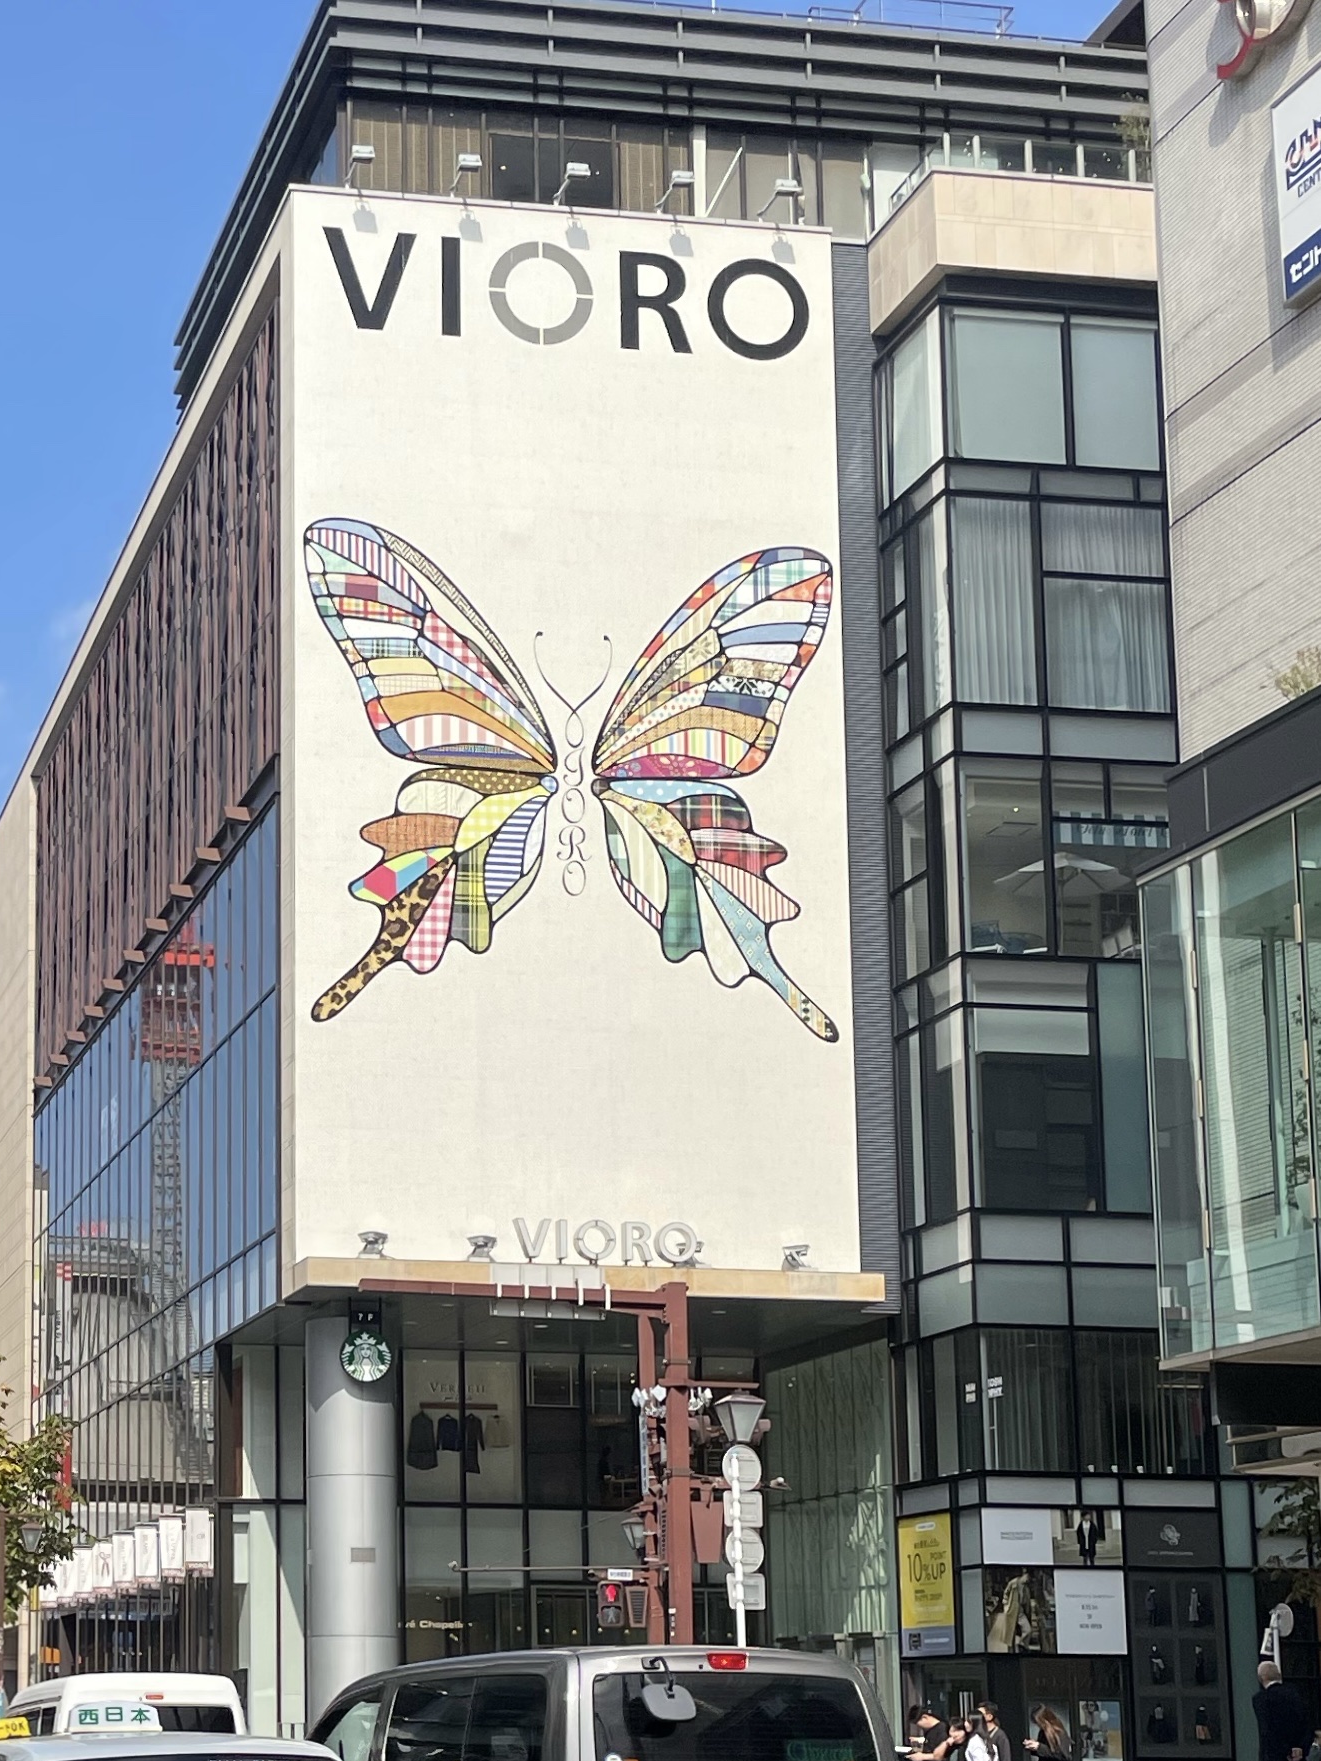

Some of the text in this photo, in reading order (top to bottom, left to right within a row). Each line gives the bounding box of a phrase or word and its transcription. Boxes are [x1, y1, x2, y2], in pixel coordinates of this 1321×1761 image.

[322, 226, 810, 360] VIORO
[512, 1217, 698, 1263] VIORO
[430, 1382, 486, 1393] VEREIL
[931, 1562, 946, 1580] UP
[79, 1707, 150, 1725] 西日本
